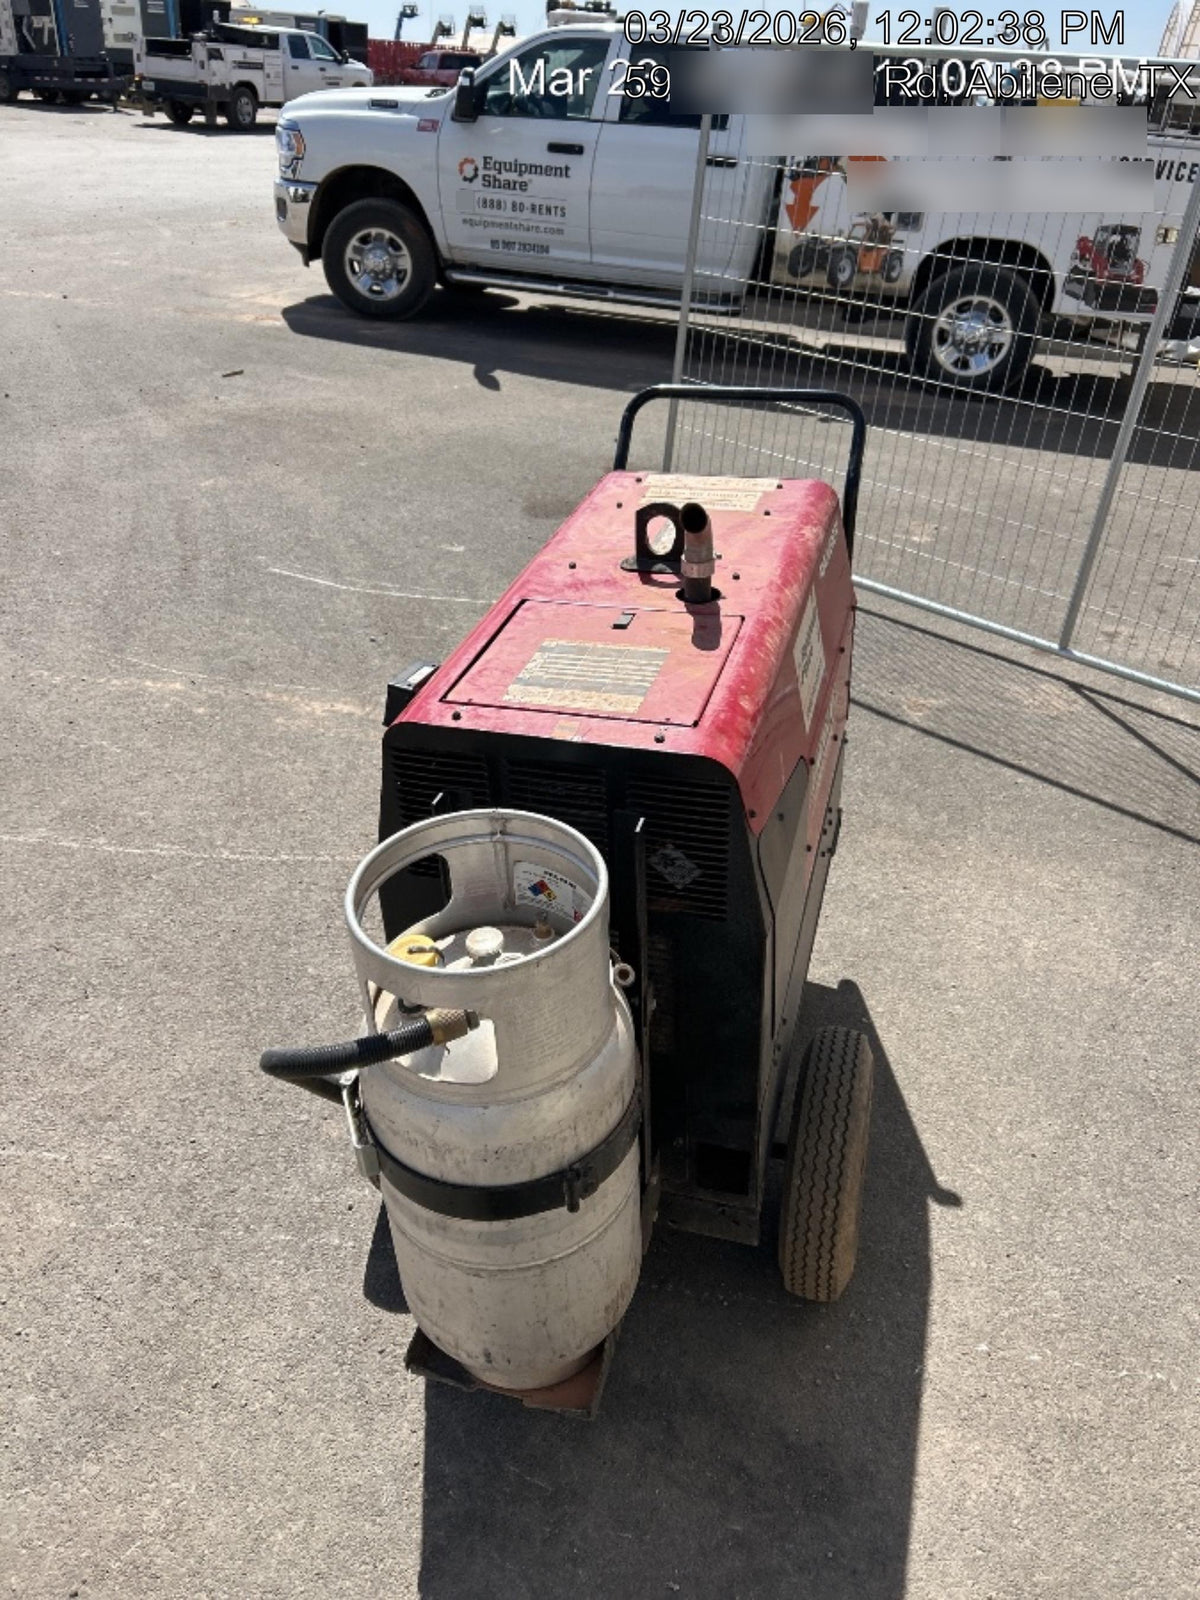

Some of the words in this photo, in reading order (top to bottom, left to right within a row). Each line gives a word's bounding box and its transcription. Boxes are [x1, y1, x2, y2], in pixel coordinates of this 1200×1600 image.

[482, 155, 571, 179] Equipment
[477, 197, 507, 213] (888)
[462, 218, 565, 236] equipmentshare.com
